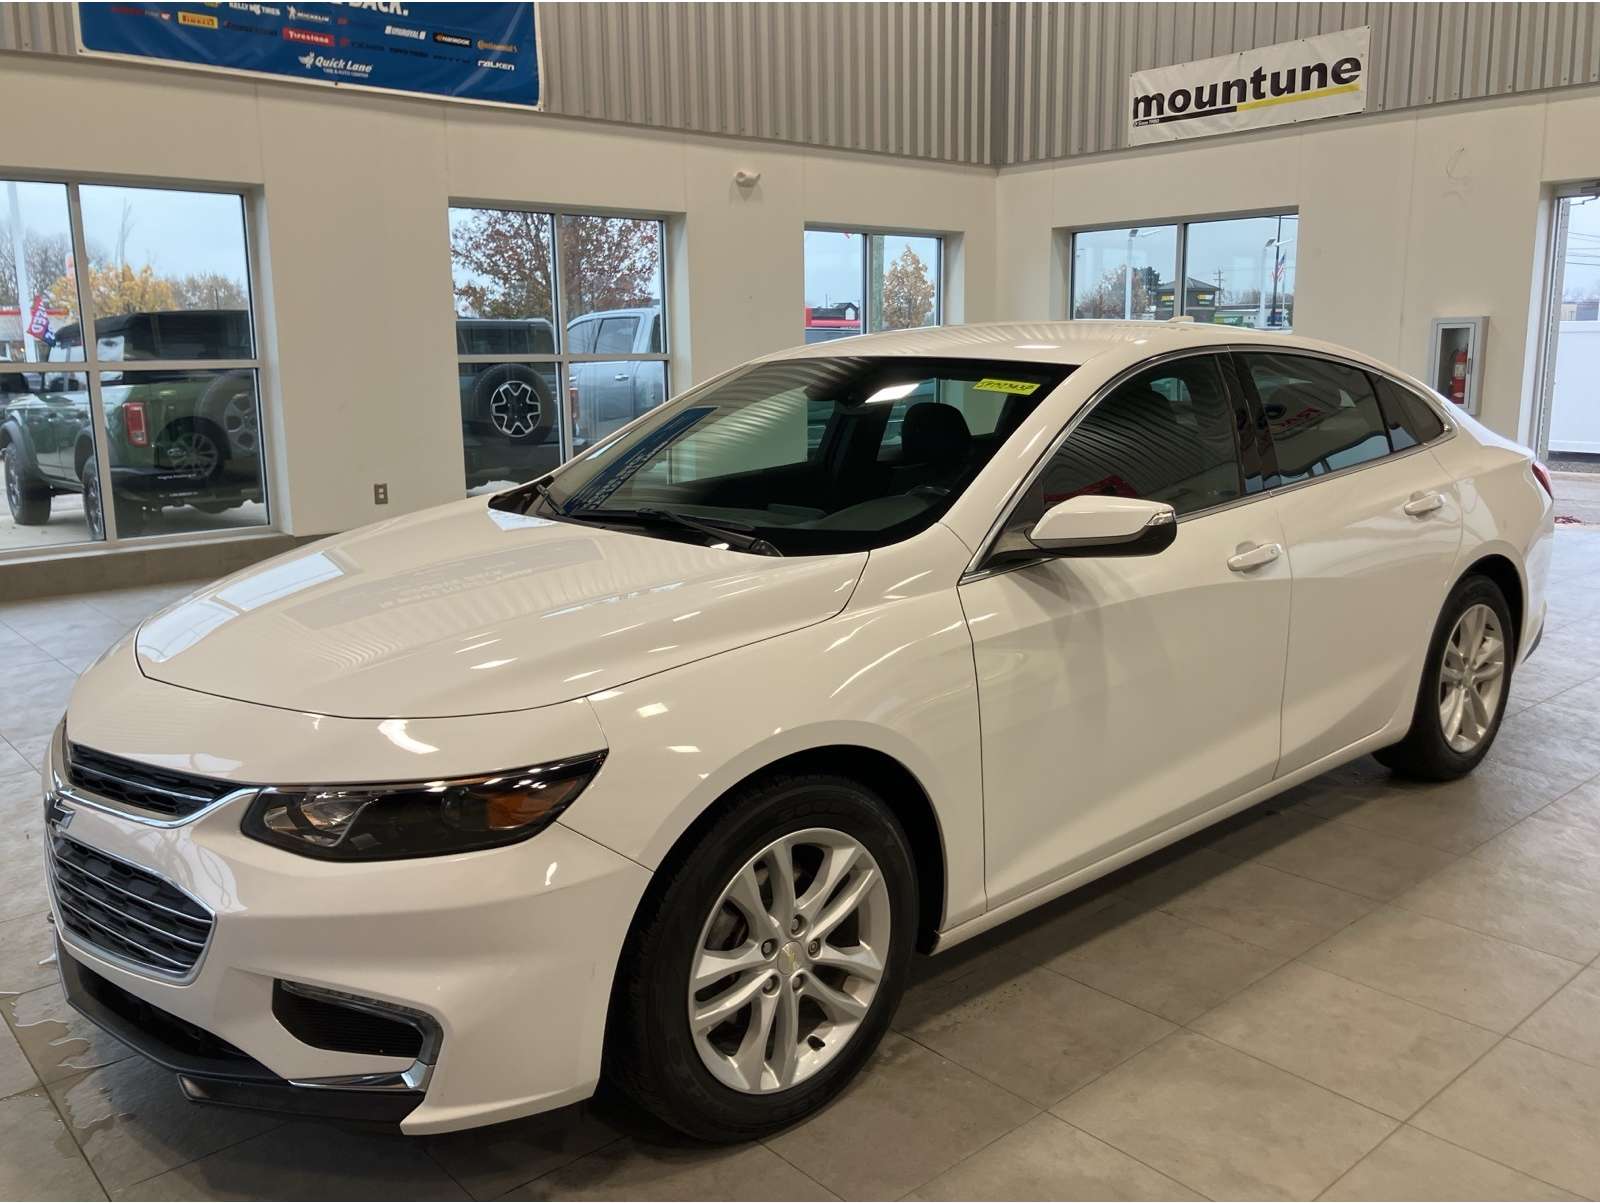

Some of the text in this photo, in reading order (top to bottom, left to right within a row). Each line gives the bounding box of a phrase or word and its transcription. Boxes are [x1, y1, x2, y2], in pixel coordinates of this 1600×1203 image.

[315, 56, 372, 73] Quick Lane
[1133, 57, 1361, 120] mountune
